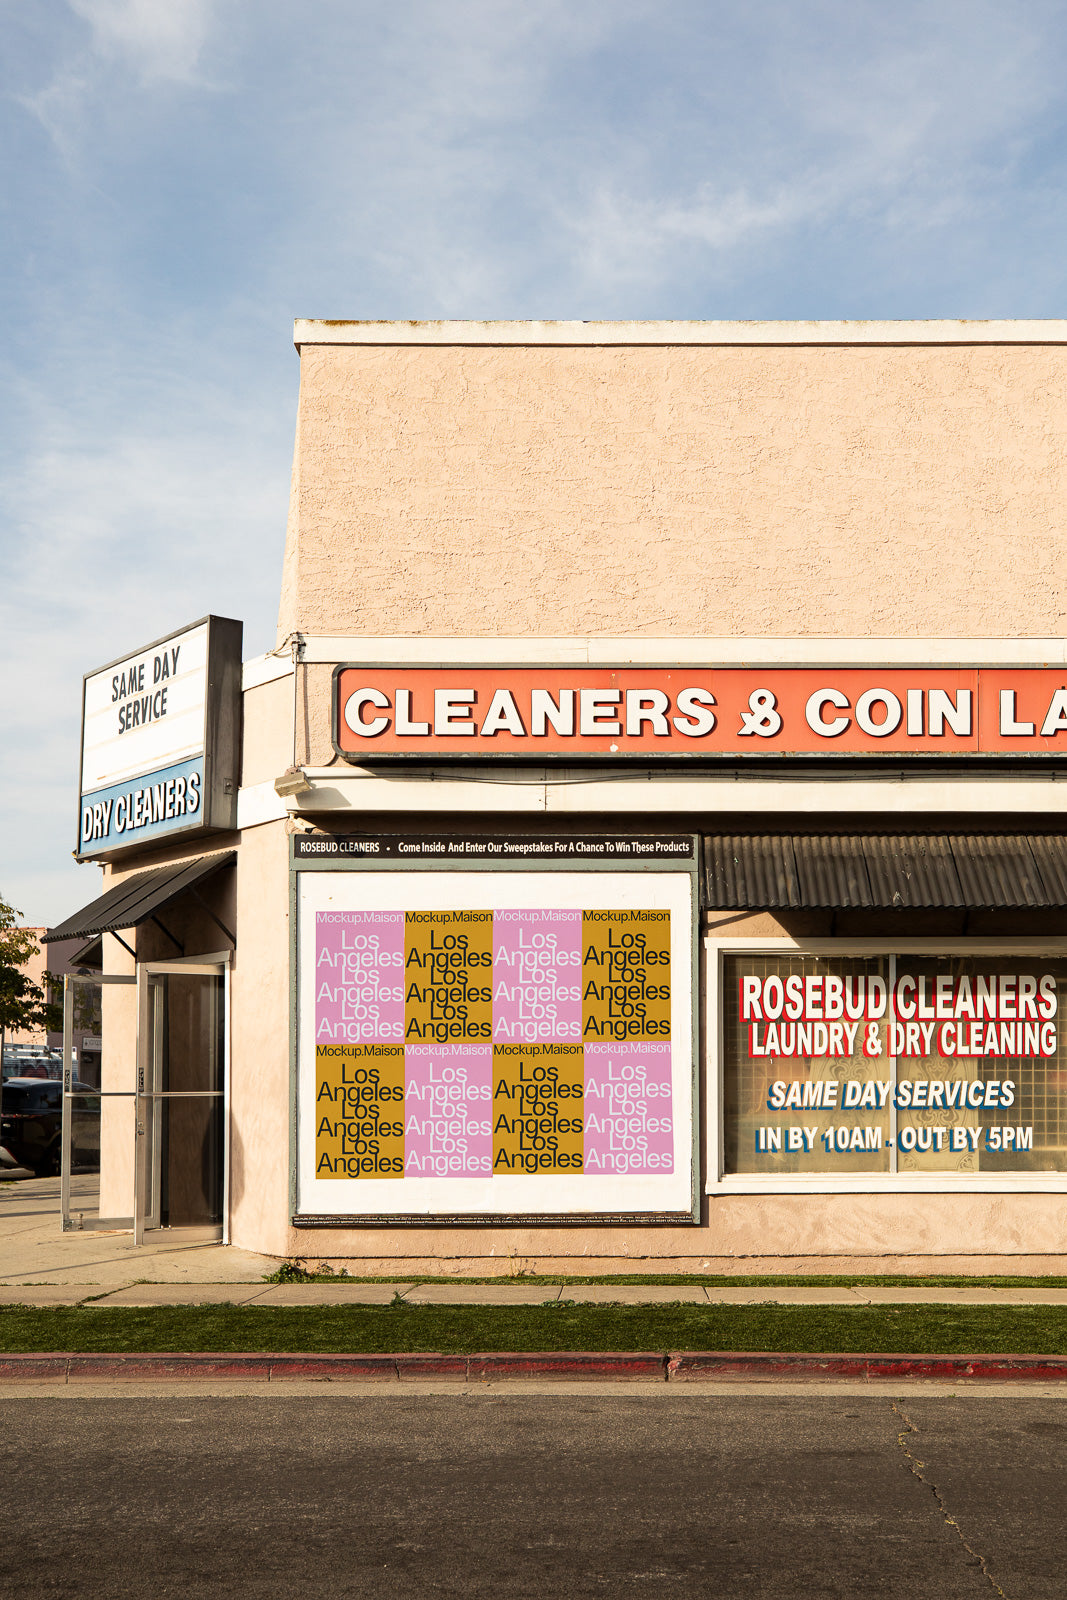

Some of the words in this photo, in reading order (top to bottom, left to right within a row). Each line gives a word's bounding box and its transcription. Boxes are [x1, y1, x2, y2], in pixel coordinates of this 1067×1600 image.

[112, 664, 145, 702] SAME
[153, 646, 180, 684] DAY
[118, 687, 168, 734] SERVICE
[344, 687, 718, 737] CLEANERS
[737, 688, 783, 737] &
[805, 688, 973, 737] COIN
[82, 798, 114, 842] DRY
[115, 772, 200, 833] CLEANERS
[300, 842, 338, 853] ROSEBUD
[339, 842, 380, 853] CLEANERS
[398, 842, 421, 853] Come
[422, 842, 445, 853] Inside
[448, 842, 464, 853] And
[466, 842, 486, 853] Enter
[488, 842, 503, 852] Our
[504, 842, 553, 855] Sweepstakes
[555, 842, 568, 852] For
[569, 842, 574, 852] A
[576, 842, 604, 852] Chance
[605, 842, 614, 852] To
[615, 842, 630, 852] Win
[632, 842, 654, 854] These
[656, 842, 690, 852] Products
[316, 913, 403, 924] Mockup.Maison
[405, 912, 492, 924] Mockup.Maison
[493, 911, 582, 922] Mockup.Maison
[582, 910, 671, 922] Mockup.Maison
[341, 930, 379, 950] Los
[430, 930, 468, 950] Los
[519, 928, 557, 948] Los
[608, 928, 647, 948] Los
[317, 948, 404, 973] Angeles
[406, 948, 492, 973] Angeles
[493, 946, 581, 972] Angeles
[583, 945, 670, 971] Angeles
[341, 966, 379, 985] Los
[430, 966, 468, 985] Los
[519, 964, 557, 983] Los
[608, 963, 647, 982] Los
[317, 982, 404, 1008] Angeles
[406, 983, 492, 1008] Angeles
[493, 981, 581, 1006] Angeles
[583, 981, 671, 1005] Angeles
[740, 975, 886, 1022] ROSEBUD
[894, 974, 1057, 1022] CLEANERS
[341, 1001, 379, 1020] Los
[430, 1001, 468, 1020] Los
[519, 1000, 557, 1019] Los
[608, 998, 647, 1018] Los
[317, 1018, 404, 1043] Angeles
[406, 1018, 492, 1043] Angeles
[493, 1017, 581, 1042] Angeles
[583, 1015, 671, 1041] Angeles
[584, 1042, 671, 1054] Mockup.Maison
[749, 1023, 859, 1057] LAUNDRY
[863, 1022, 882, 1057] &
[887, 1022, 936, 1057] DRY
[938, 1022, 1057, 1057] CLEANING
[316, 1045, 404, 1057] Mockup.Maison
[405, 1045, 492, 1057] Mockup.Maison
[493, 1044, 584, 1056] Mockup.Maison
[341, 1064, 380, 1084] Los
[429, 1062, 468, 1082] Los
[519, 1062, 558, 1082] Los
[608, 1061, 647, 1081] Los
[317, 1081, 403, 1107] Angeles
[405, 1080, 492, 1105] Angeles
[494, 1079, 583, 1105] Angeles
[584, 1078, 671, 1103] Angeles
[767, 1080, 838, 1110] SAME
[841, 1080, 892, 1110] DAY
[894, 1080, 1015, 1110] SERVICES
[341, 1100, 380, 1120] Los
[429, 1098, 468, 1118] Los
[519, 1097, 558, 1116] Los
[609, 1096, 647, 1116] Los
[317, 1117, 403, 1142] Angeles
[405, 1115, 492, 1140] Angeles
[494, 1114, 583, 1139] Angeles
[584, 1113, 672, 1138] Angeles
[341, 1135, 380, 1155] Los
[429, 1134, 468, 1153] Los
[519, 1132, 558, 1151] Los
[609, 1131, 648, 1151] Los
[756, 1127, 782, 1152] IN
[785, 1127, 818, 1152] BY
[822, 1127, 882, 1152] 10AM
[898, 1127, 947, 1152] OUT
[950, 1127, 984, 1152] BY
[986, 1127, 1033, 1152] 5PM
[317, 1152, 403, 1178] Angeles
[405, 1151, 492, 1176] Angeles
[494, 1148, 583, 1173] Angeles
[584, 1148, 672, 1173] Angeles
